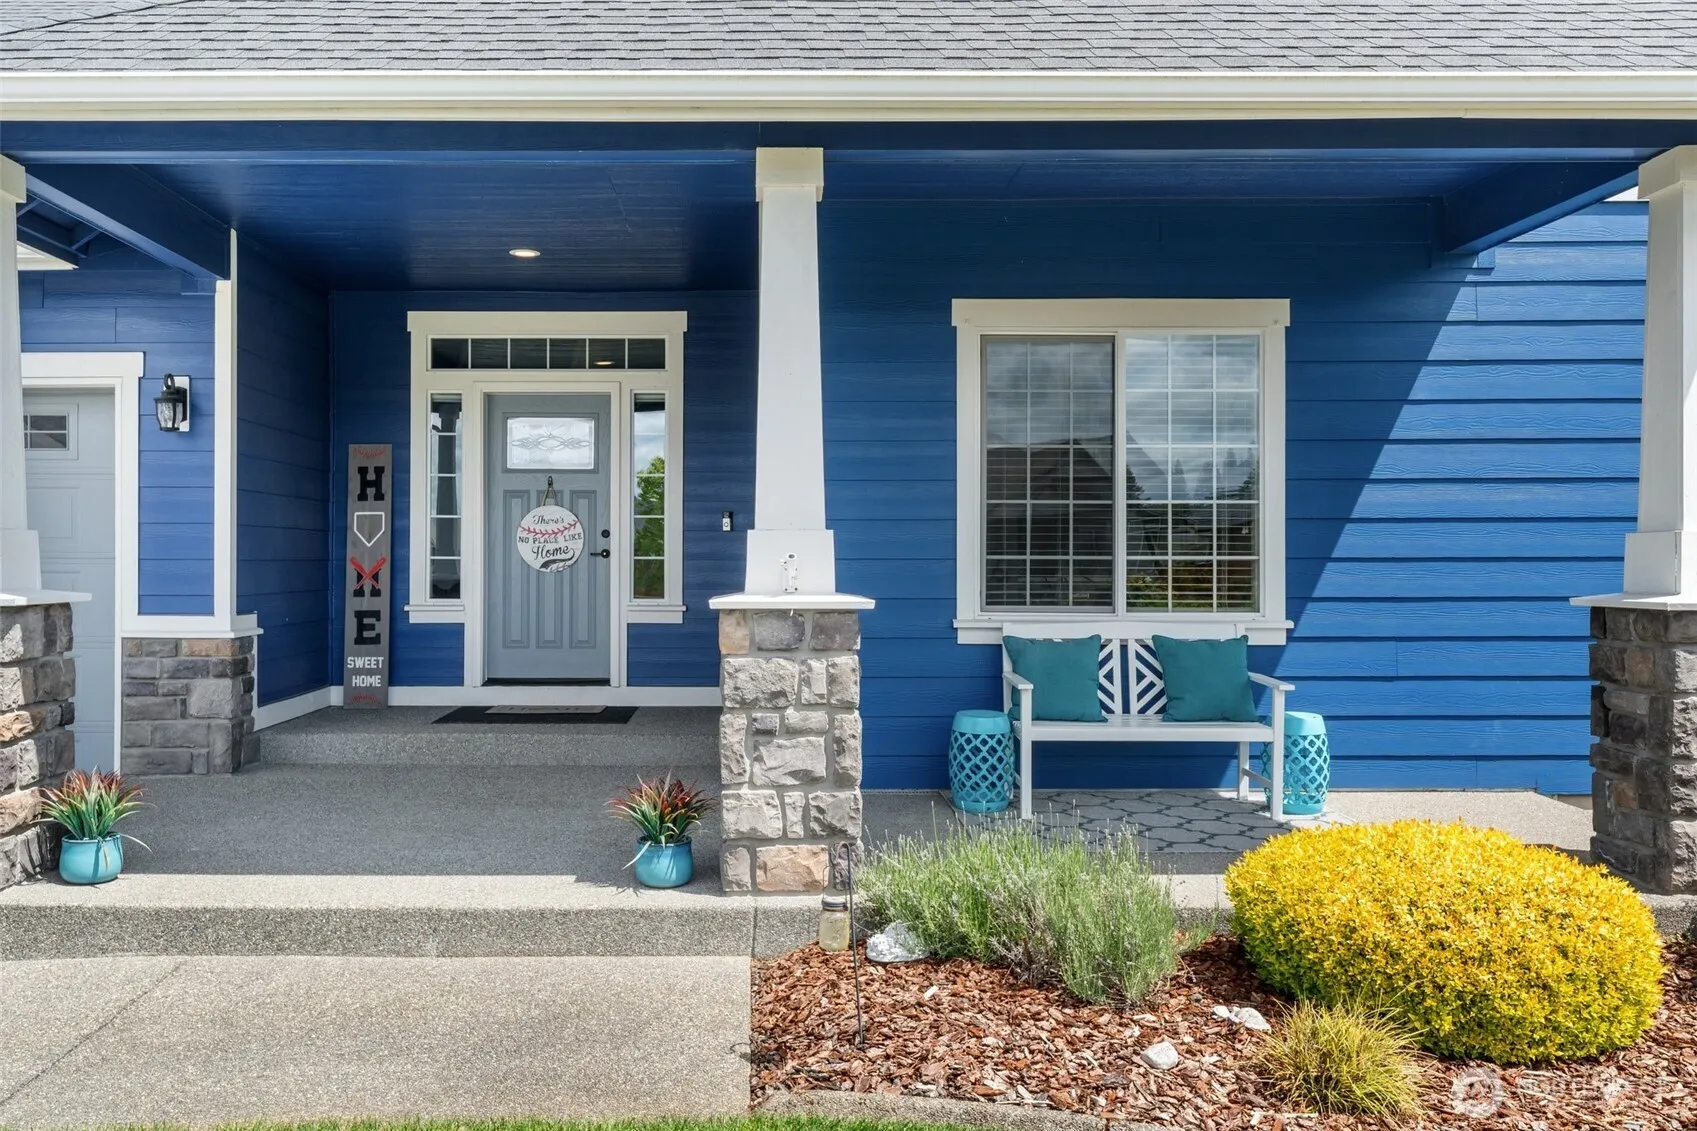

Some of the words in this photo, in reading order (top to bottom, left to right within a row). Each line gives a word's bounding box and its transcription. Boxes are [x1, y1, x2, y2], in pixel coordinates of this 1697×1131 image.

[532, 514, 565, 525] There's
[518, 535, 530, 544] NO
[532, 537, 559, 545] PLACE
[563, 532, 583, 543] LIKE
[531, 545, 570, 560] Home
[347, 656, 384, 669] SWEET
[352, 675, 382, 687] HOME
